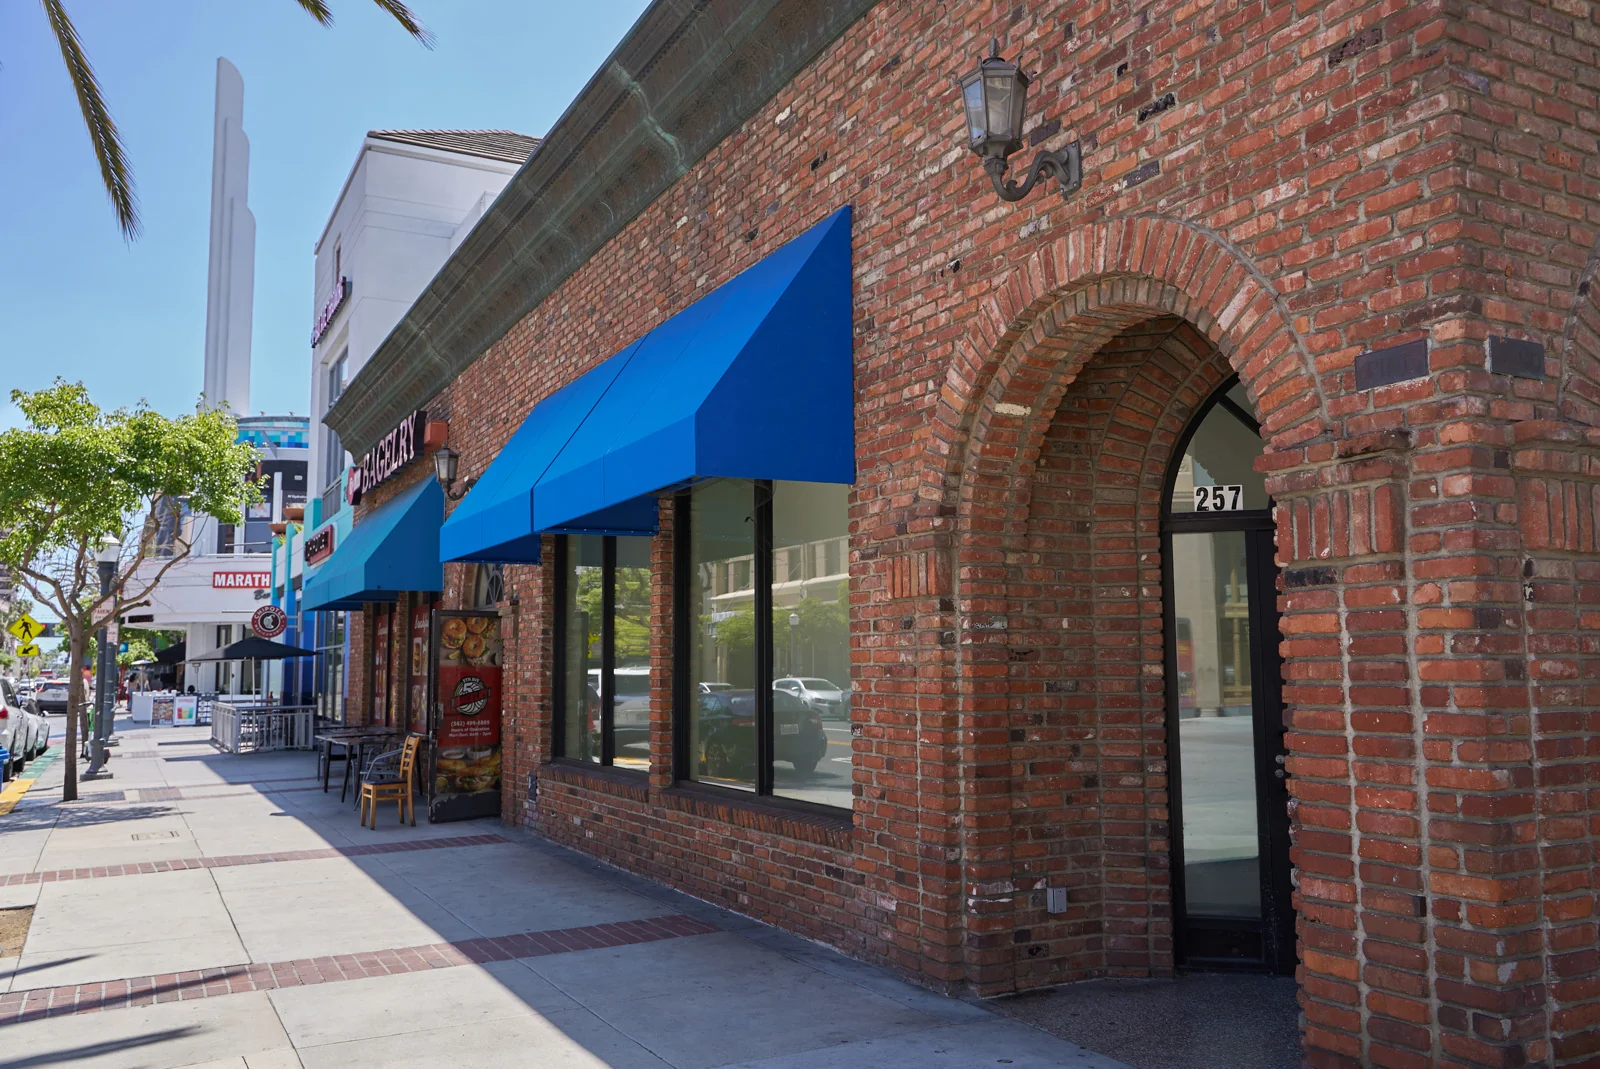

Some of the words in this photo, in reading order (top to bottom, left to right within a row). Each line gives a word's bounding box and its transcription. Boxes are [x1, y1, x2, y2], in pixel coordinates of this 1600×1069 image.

[362, 410, 416, 495] BAGELRY
[1195, 486, 1241, 512] 257
[214, 573, 270, 587] MARATH
[254, 606, 285, 620] CHIPOTLE
